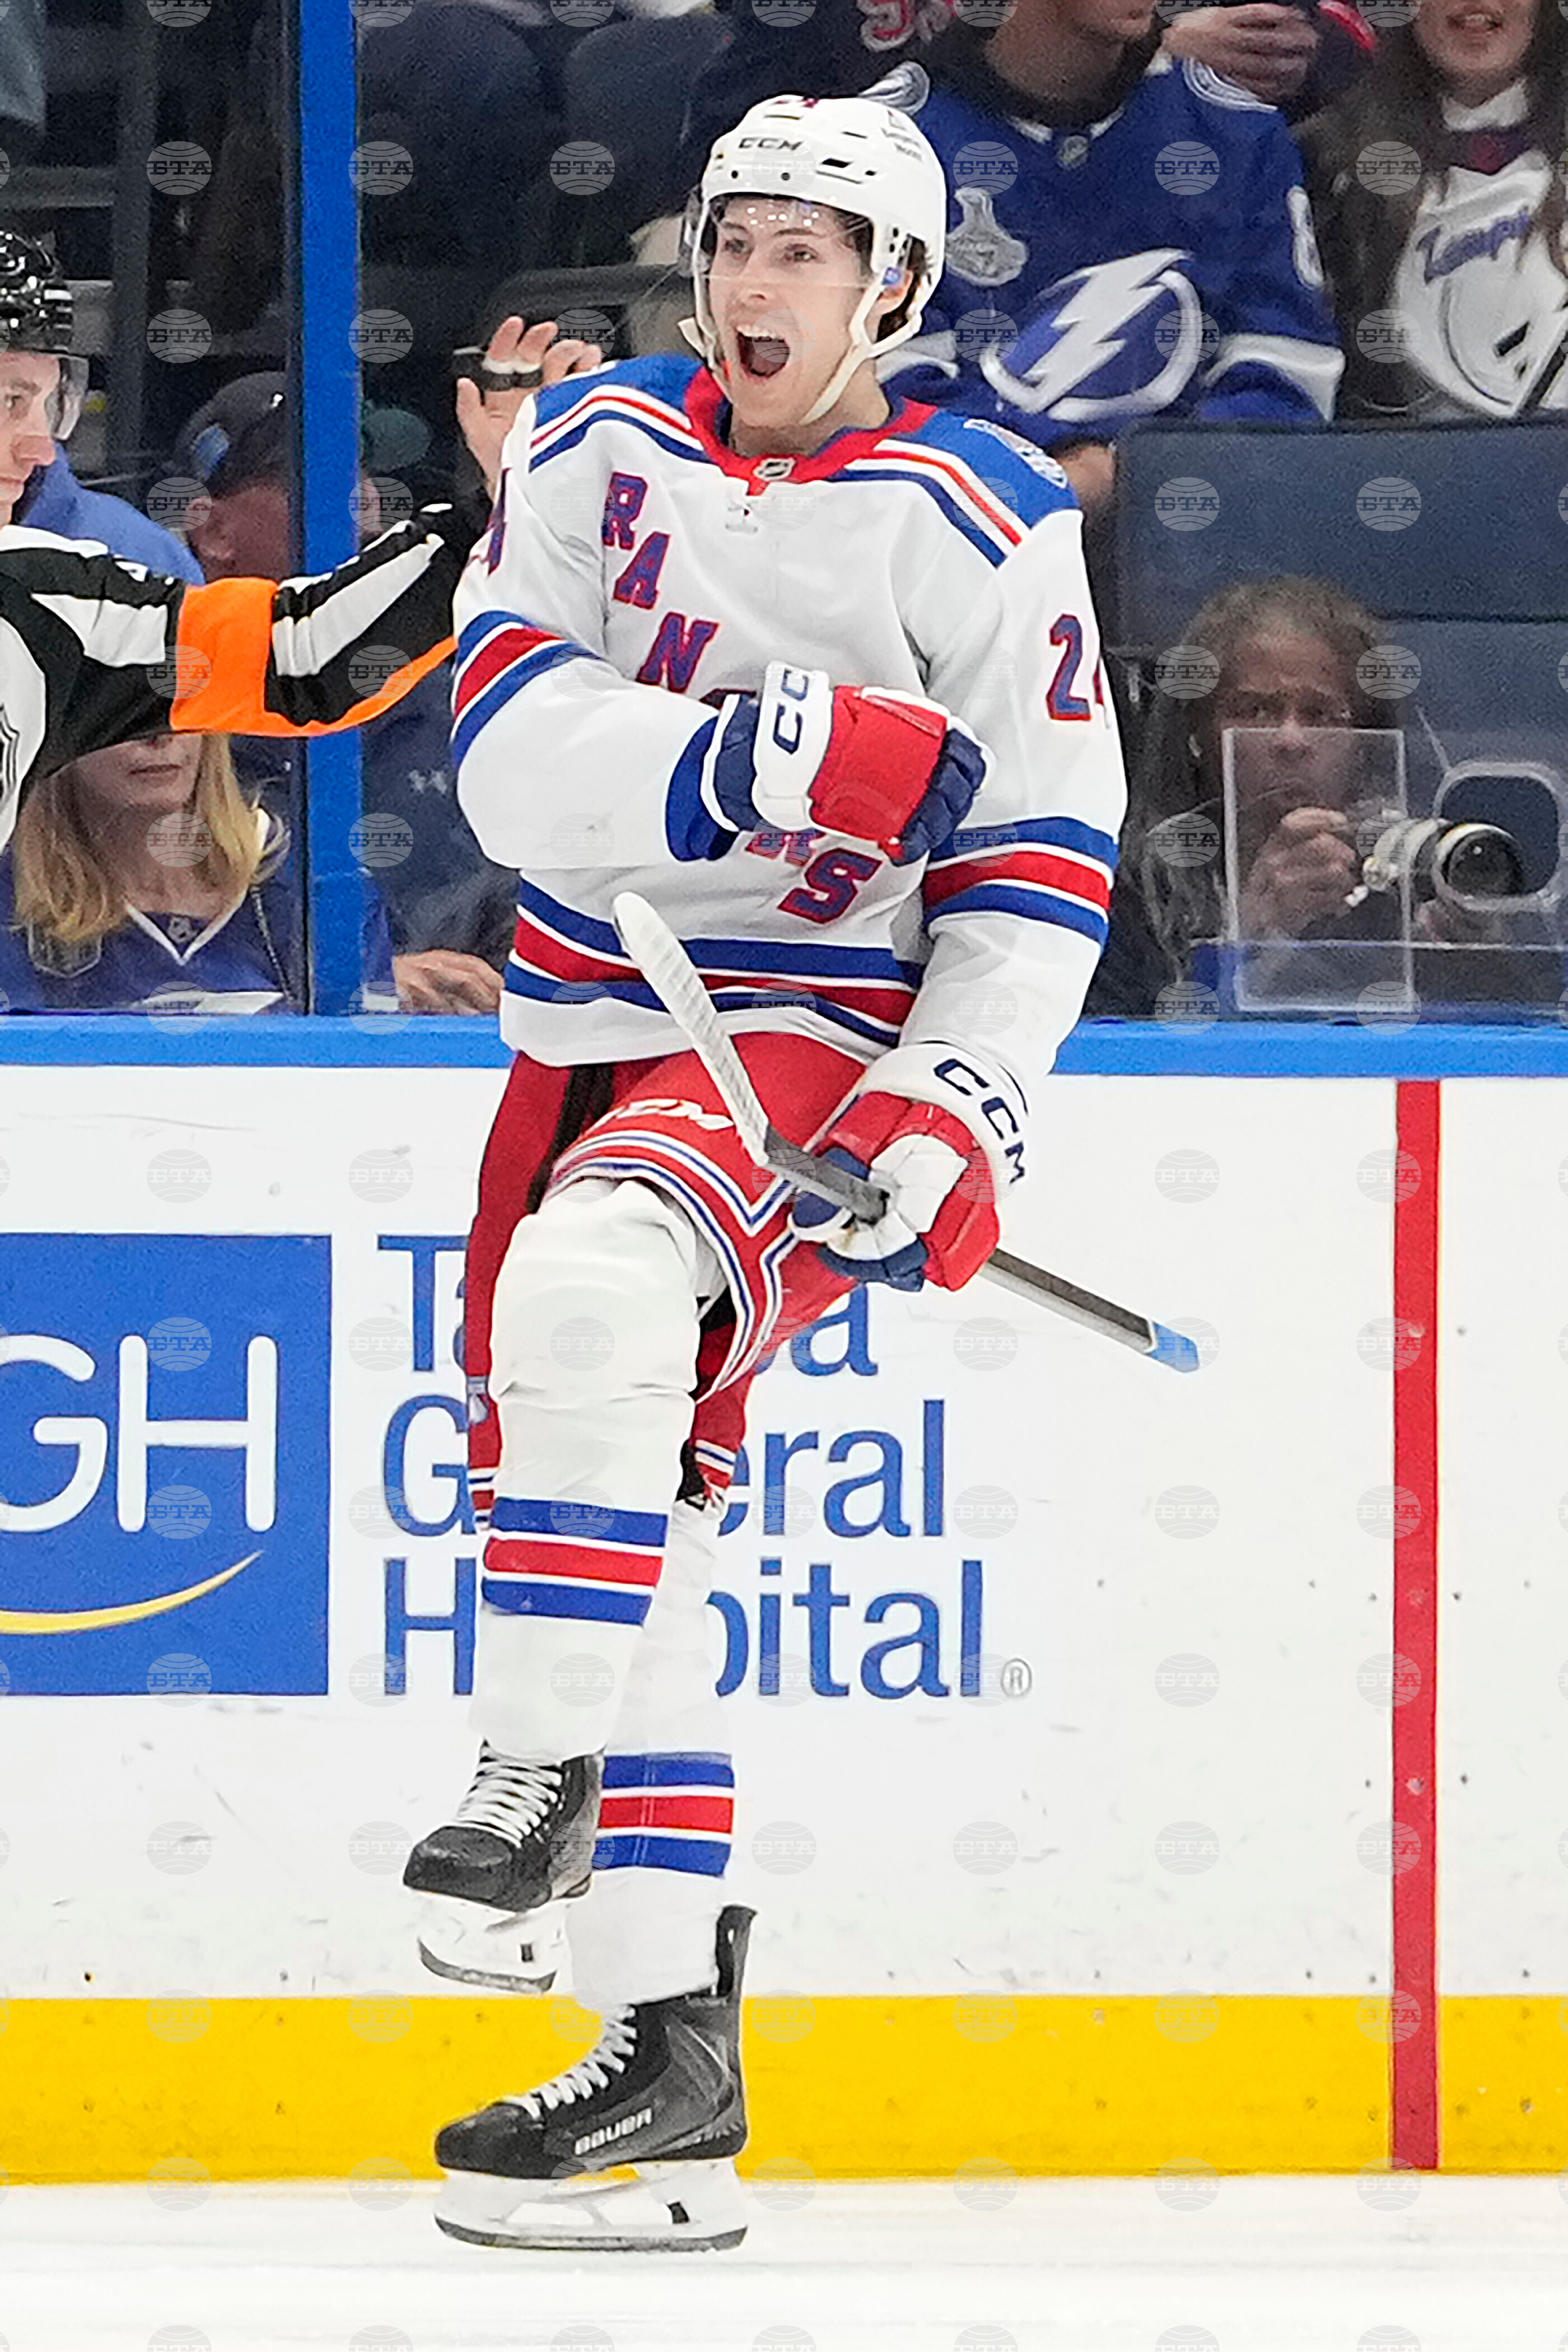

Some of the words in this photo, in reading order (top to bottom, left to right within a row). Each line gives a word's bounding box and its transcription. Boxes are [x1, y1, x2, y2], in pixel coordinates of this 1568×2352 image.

[738, 137, 804, 150] CCM
[772, 667, 810, 755] CC
[1046, 613, 1105, 721] 2
[934, 1058, 1025, 1185] CCM
[384, 1394, 945, 1538] Gral
[384, 1556, 983, 1700] Hital
